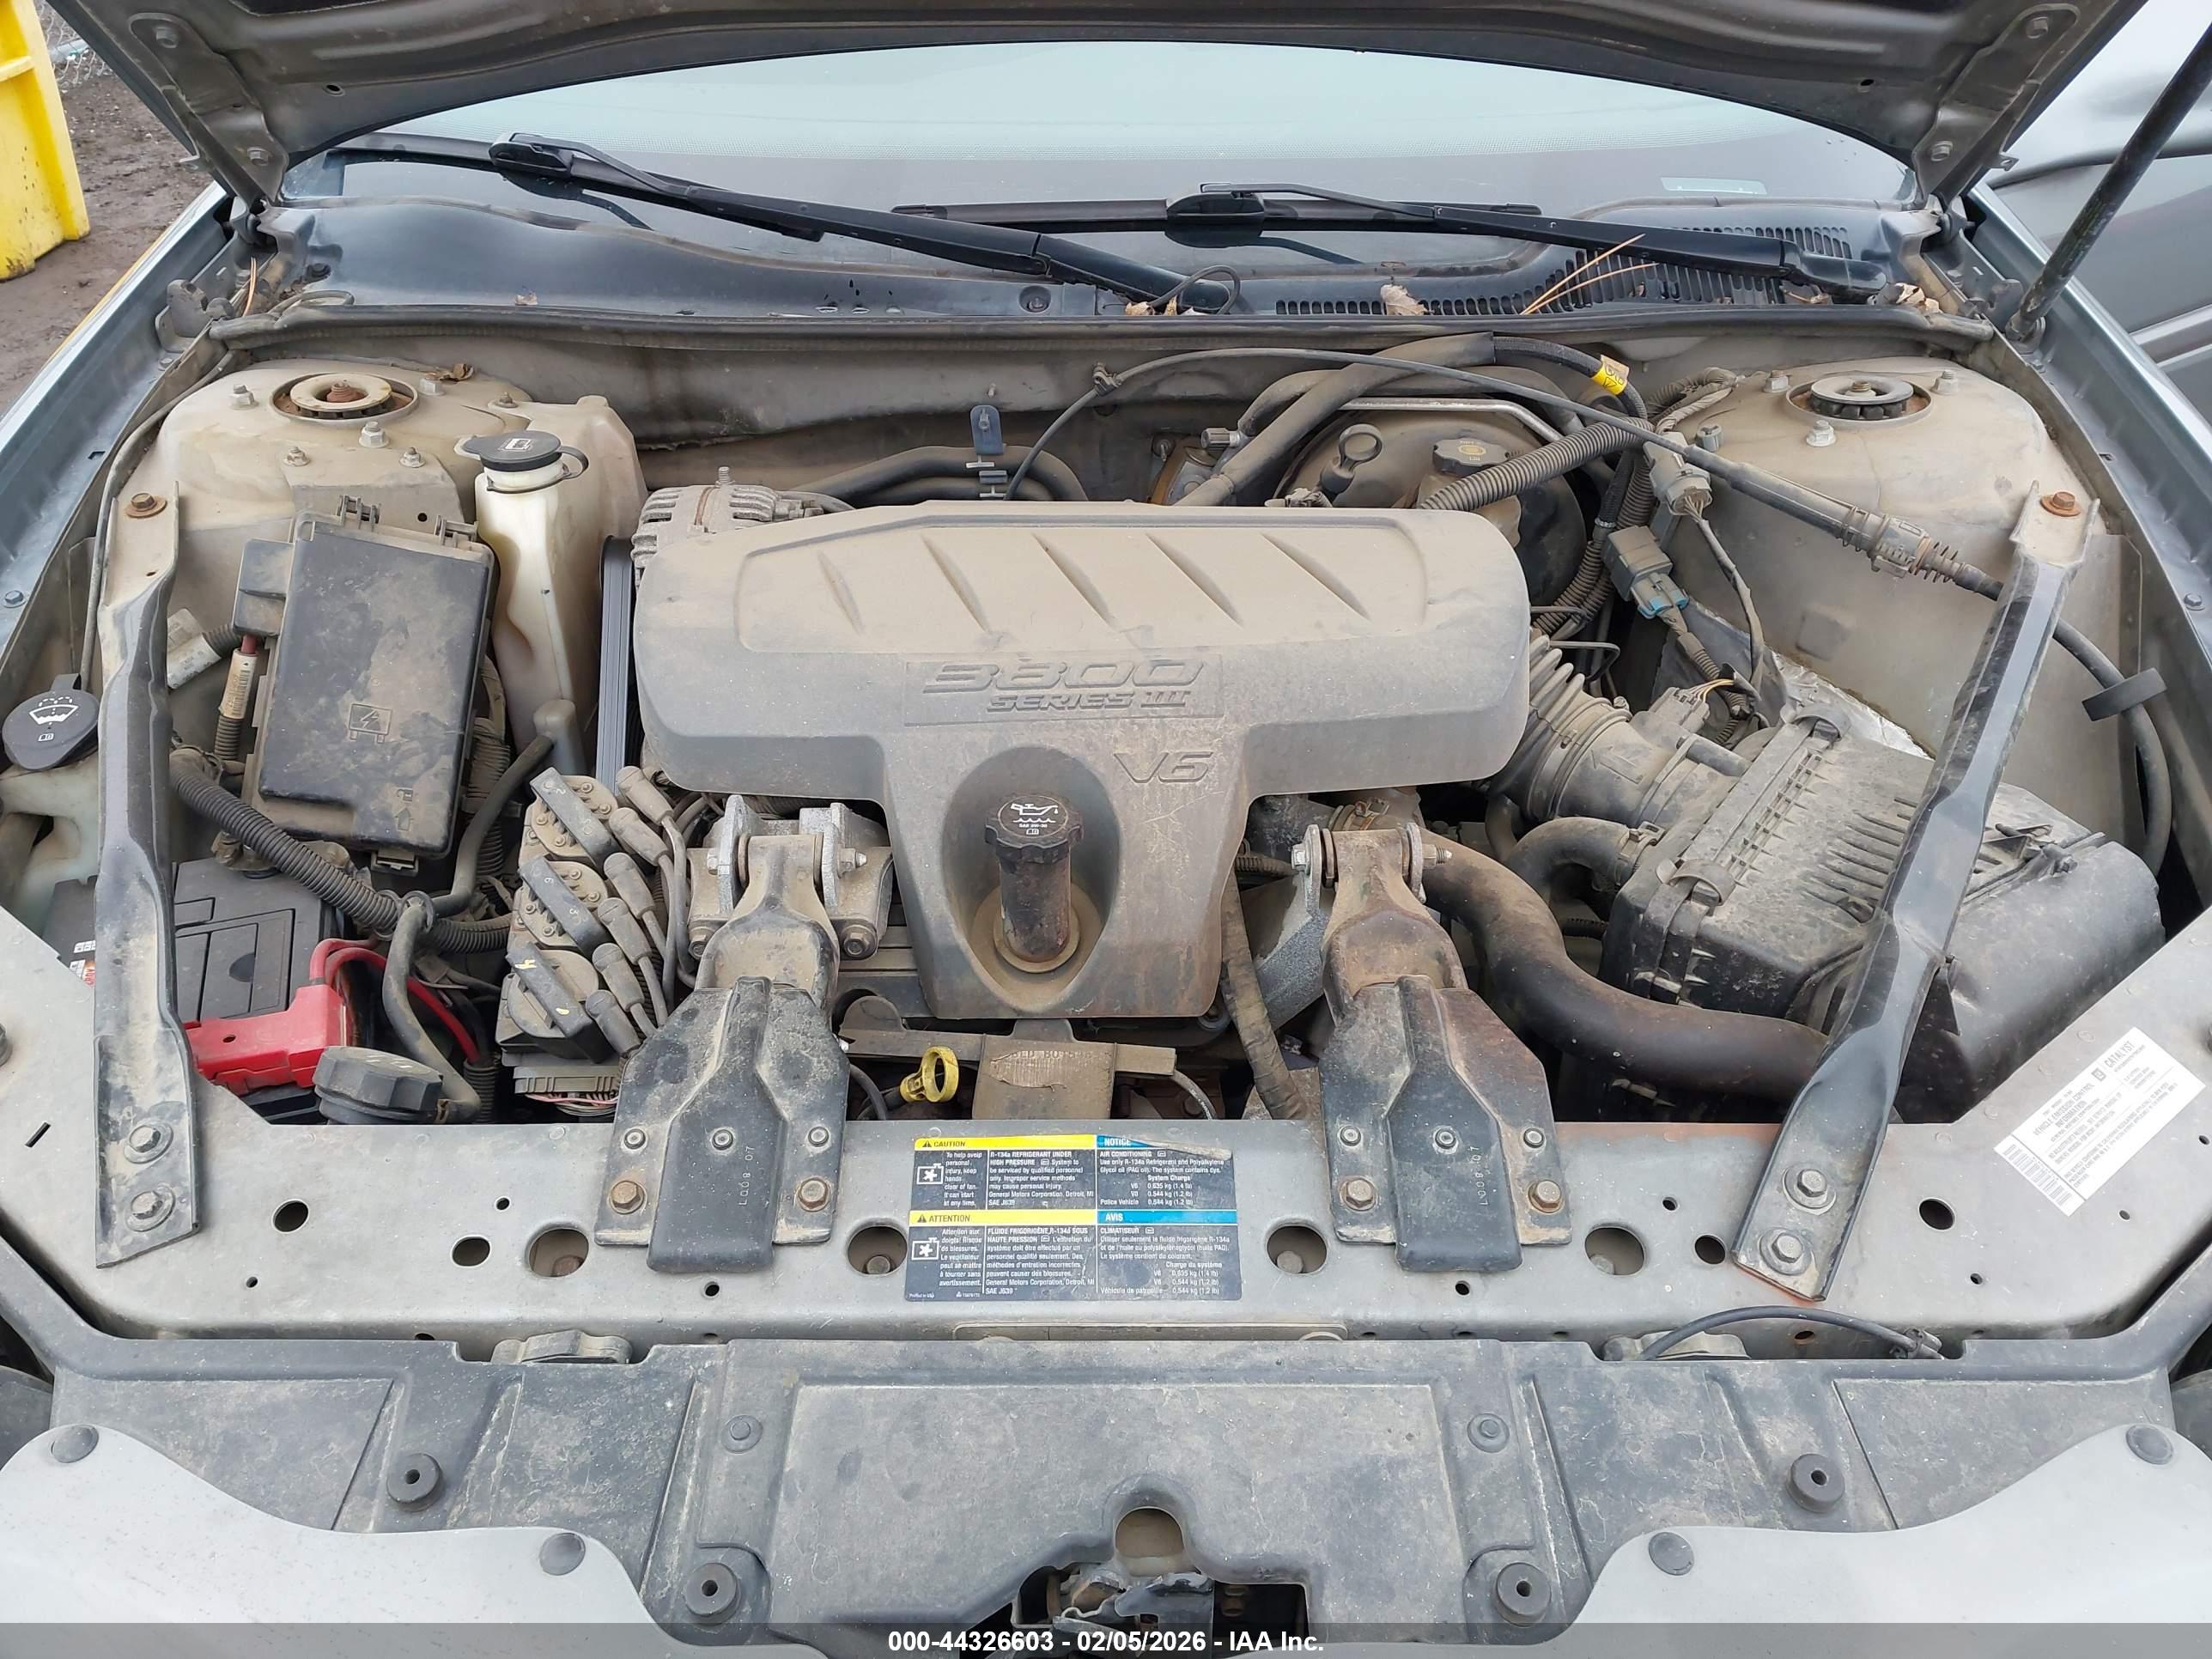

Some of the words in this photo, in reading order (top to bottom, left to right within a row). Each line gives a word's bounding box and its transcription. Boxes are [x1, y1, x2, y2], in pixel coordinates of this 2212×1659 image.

[923, 660, 1204, 693] 3800
[988, 692, 1134, 712] SERIES
[1140, 690, 1191, 708] III
[1115, 751, 1213, 783] V6
[2104, 1040, 2135, 1068] CATALYST
[1106, 1212, 1123, 1221] AVIS
